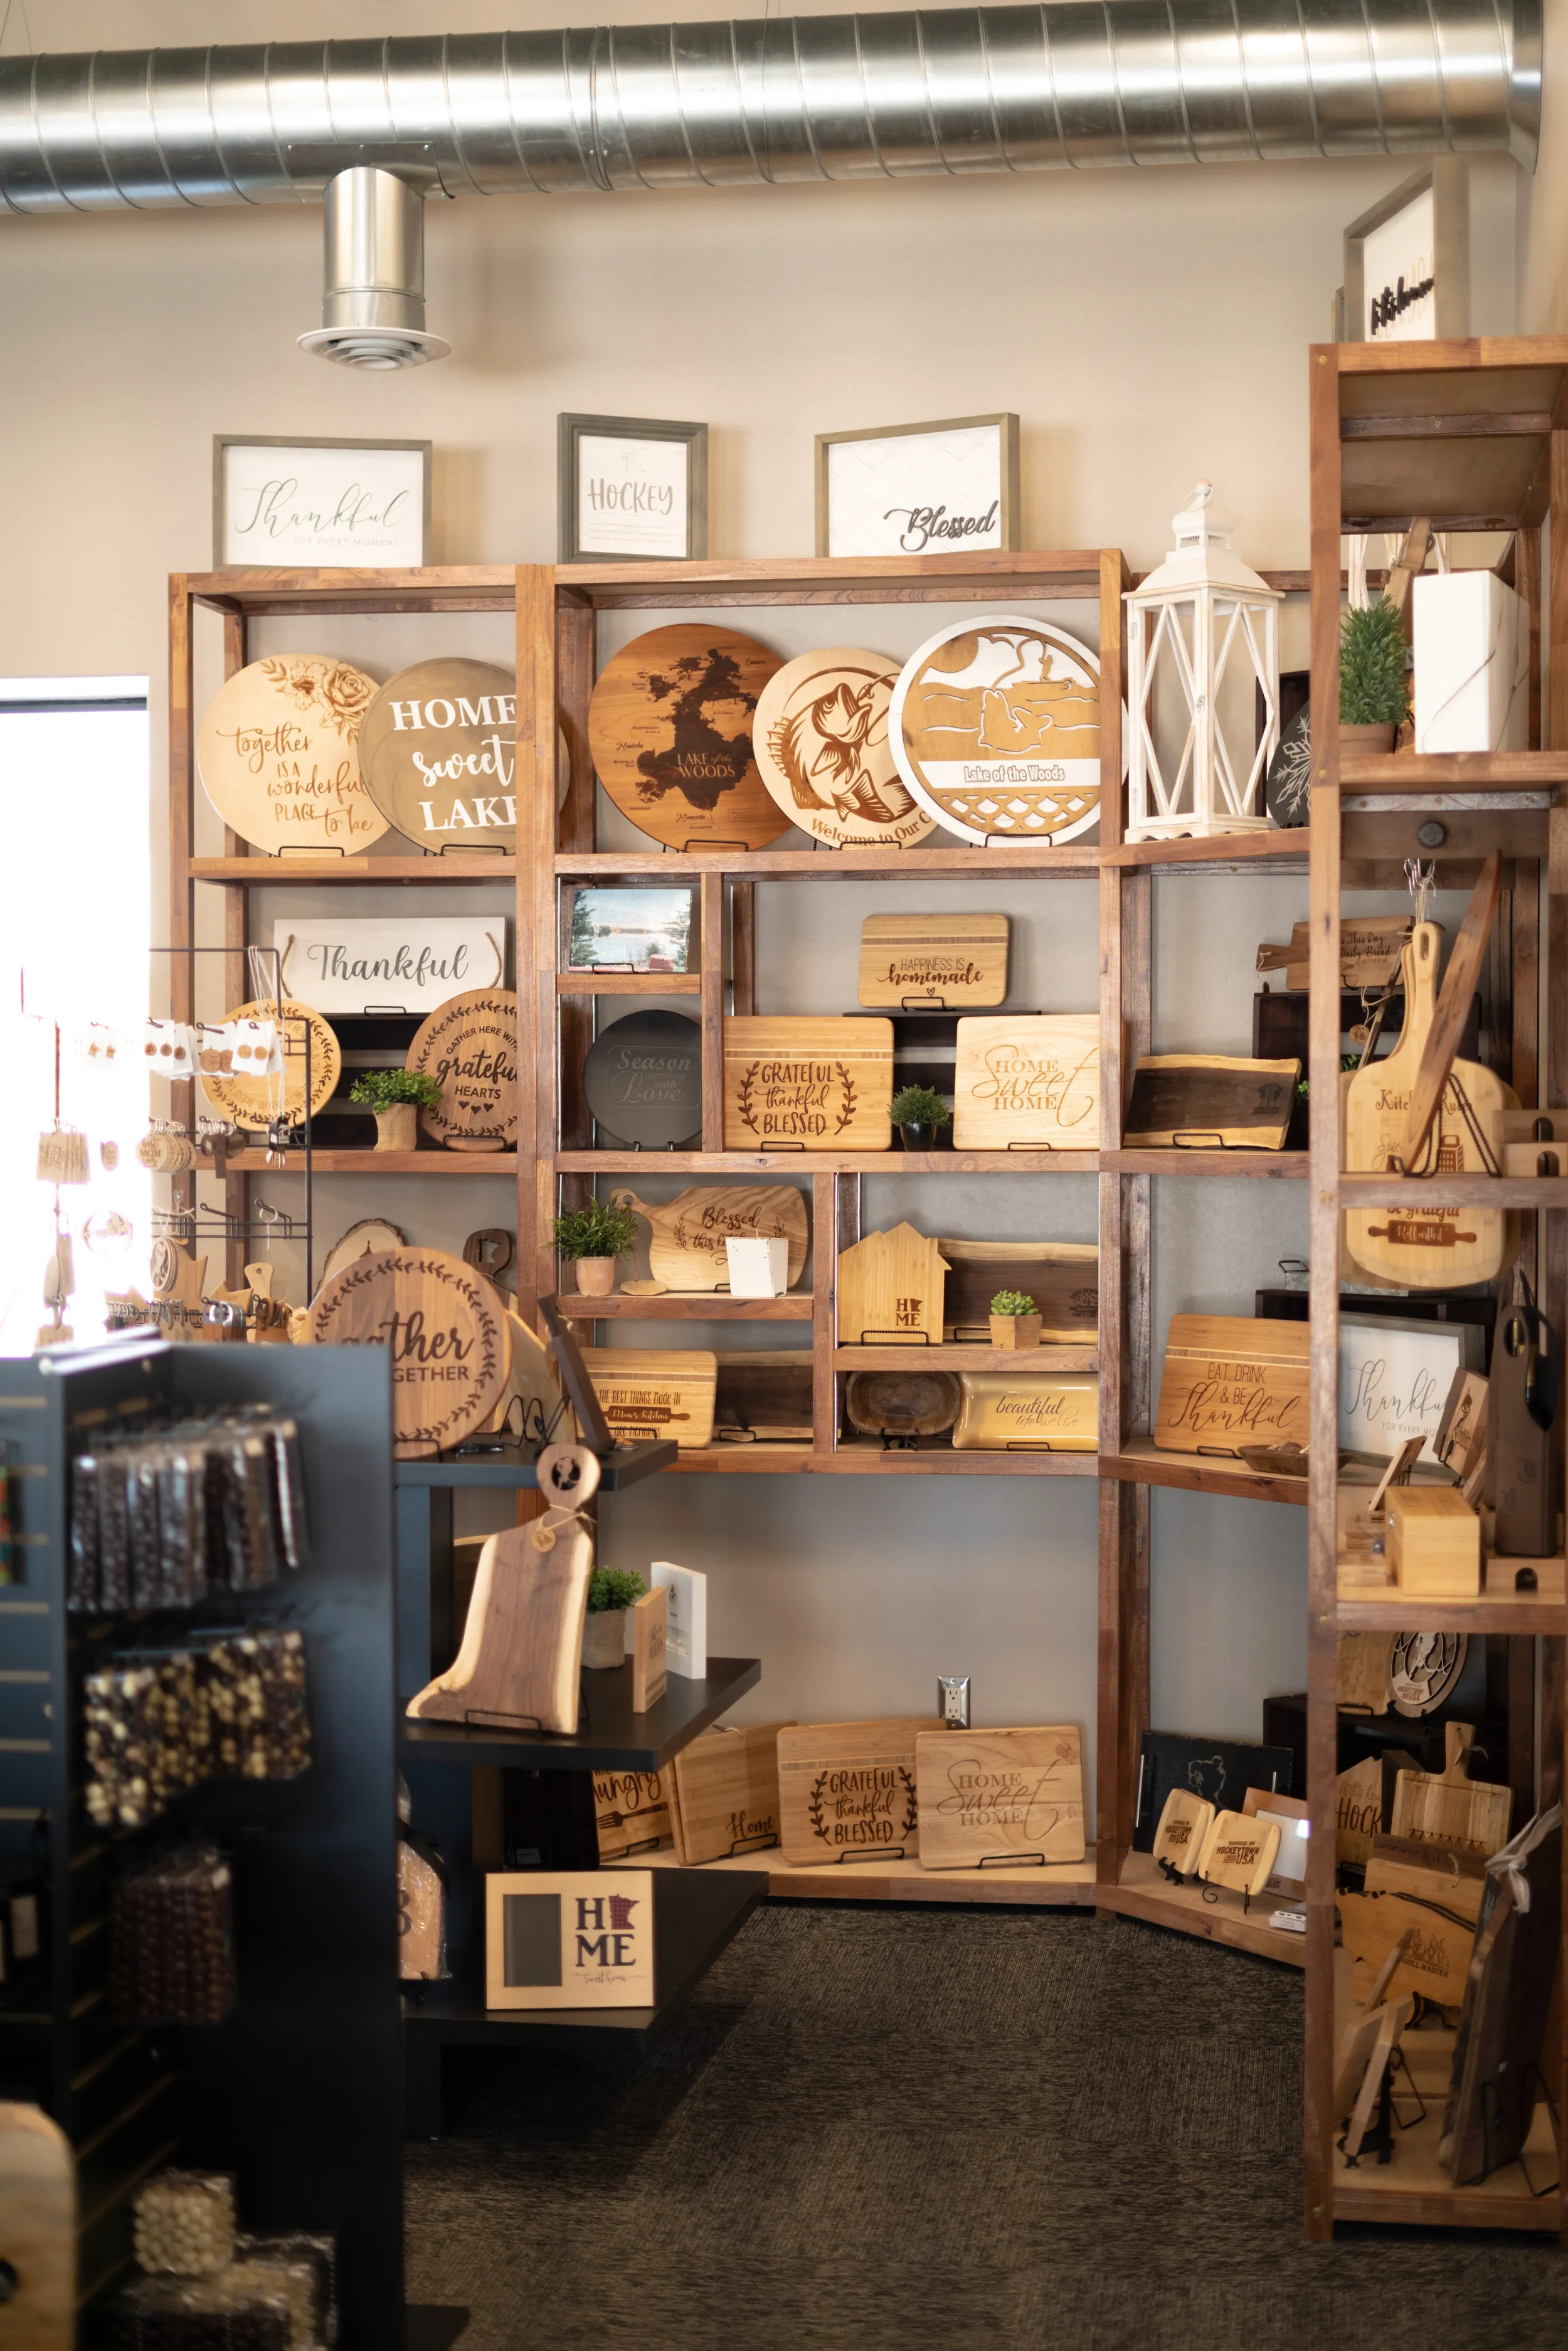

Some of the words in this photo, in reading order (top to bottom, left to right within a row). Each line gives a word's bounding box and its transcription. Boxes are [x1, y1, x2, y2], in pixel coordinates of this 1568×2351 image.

[587, 478, 674, 516] HOCKEY
[235, 479, 410, 538] Thankful
[884, 500, 999, 552] Blessed
[293, 536, 313, 546] FOR
[317, 537, 348, 546] EVERY
[353, 538, 398, 547] MOMENT
[389, 694, 516, 731] HOME
[216, 721, 313, 773] together
[616, 741, 644, 751] Manitoba
[412, 734, 516, 787] sweet
[677, 753, 709, 766] LAKE
[277, 761, 289, 777] IS
[292, 762, 300, 777] A
[678, 765, 735, 778] WOODS
[963, 767, 991, 783] Lake
[993, 766, 1005, 782] of
[1006, 766, 1027, 782] the
[1028, 765, 1065, 782] Woods
[267, 761, 368, 805] wonderful
[275, 803, 318, 822] PLACE
[347, 804, 374, 835] be
[676, 812, 706, 822] Minnesota
[811, 817, 876, 846] Welcome
[894, 820, 921, 841] Our
[1347, 931, 1366, 944] This
[1367, 930, 1385, 948] Day
[1364, 945, 1392, 957] Bread
[307, 944, 469, 987] Thankful
[877, 962, 984, 985] homemade
[901, 957, 953, 972] HAPPINESS
[956, 957, 965, 971] IS
[446, 1028, 477, 1054] GATHER
[479, 1026, 502, 1036] HERE
[433, 1049, 517, 1087] gratefu
[617, 1049, 692, 1071] Season
[994, 1059, 1058, 1073] HOME
[645, 1071, 685, 1080] everything
[761, 1061, 835, 1084] GRATEFUL
[455, 1085, 502, 1100] HEARTS
[612, 1070, 686, 1103] Love
[655, 1079, 676, 1088] with
[755, 1084, 830, 1109] thankful
[992, 1096, 1057, 1110] HOME
[763, 1113, 827, 1136] BLESSED
[139, 1149, 161, 1157] MOM
[702, 1206, 761, 1230] Blessed
[689, 1233, 716, 1251] this
[895, 1313, 920, 1326] ME
[1234, 1364, 1267, 1383] DRINK
[599, 1389, 610, 1403] THE
[612, 1390, 627, 1403] BEST
[630, 1391, 652, 1404] THINGS
[654, 1391, 671, 1405] Made
[674, 1392, 681, 1406] IN
[1220, 1386, 1229, 1403] &
[1233, 1387, 1248, 1405] BE
[613, 1409, 638, 1420] Mom's
[642, 1409, 668, 1421] Kitchen
[995, 1396, 1066, 1423] beautiful
[1168, 1381, 1301, 1432] Thankful
[1016, 1414, 1035, 1429] life
[1382, 1421, 1396, 1430] FOR
[1399, 1424, 1421, 1434] EVERY
[1408, 1693, 1420, 1702] USA
[830, 1768, 899, 1793] GRATEFUL
[958, 1773, 1022, 1788] HOME
[824, 1790, 894, 1822] thankful
[726, 1811, 775, 1839] Home
[960, 1810, 1023, 1826] HOME
[835, 1820, 893, 1844] BLESSED
[1165, 1825, 1192, 1834] HOCKEYTOWN
[1176, 1834, 1188, 1844] USA
[1216, 1846, 1260, 1855] HOCKEYTOWN
[1236, 1854, 1254, 1865] USA
[575, 1933, 636, 1968] ME
[1401, 1957, 1420, 1969] GRILL
[1421, 1963, 1449, 1978] MASTER
